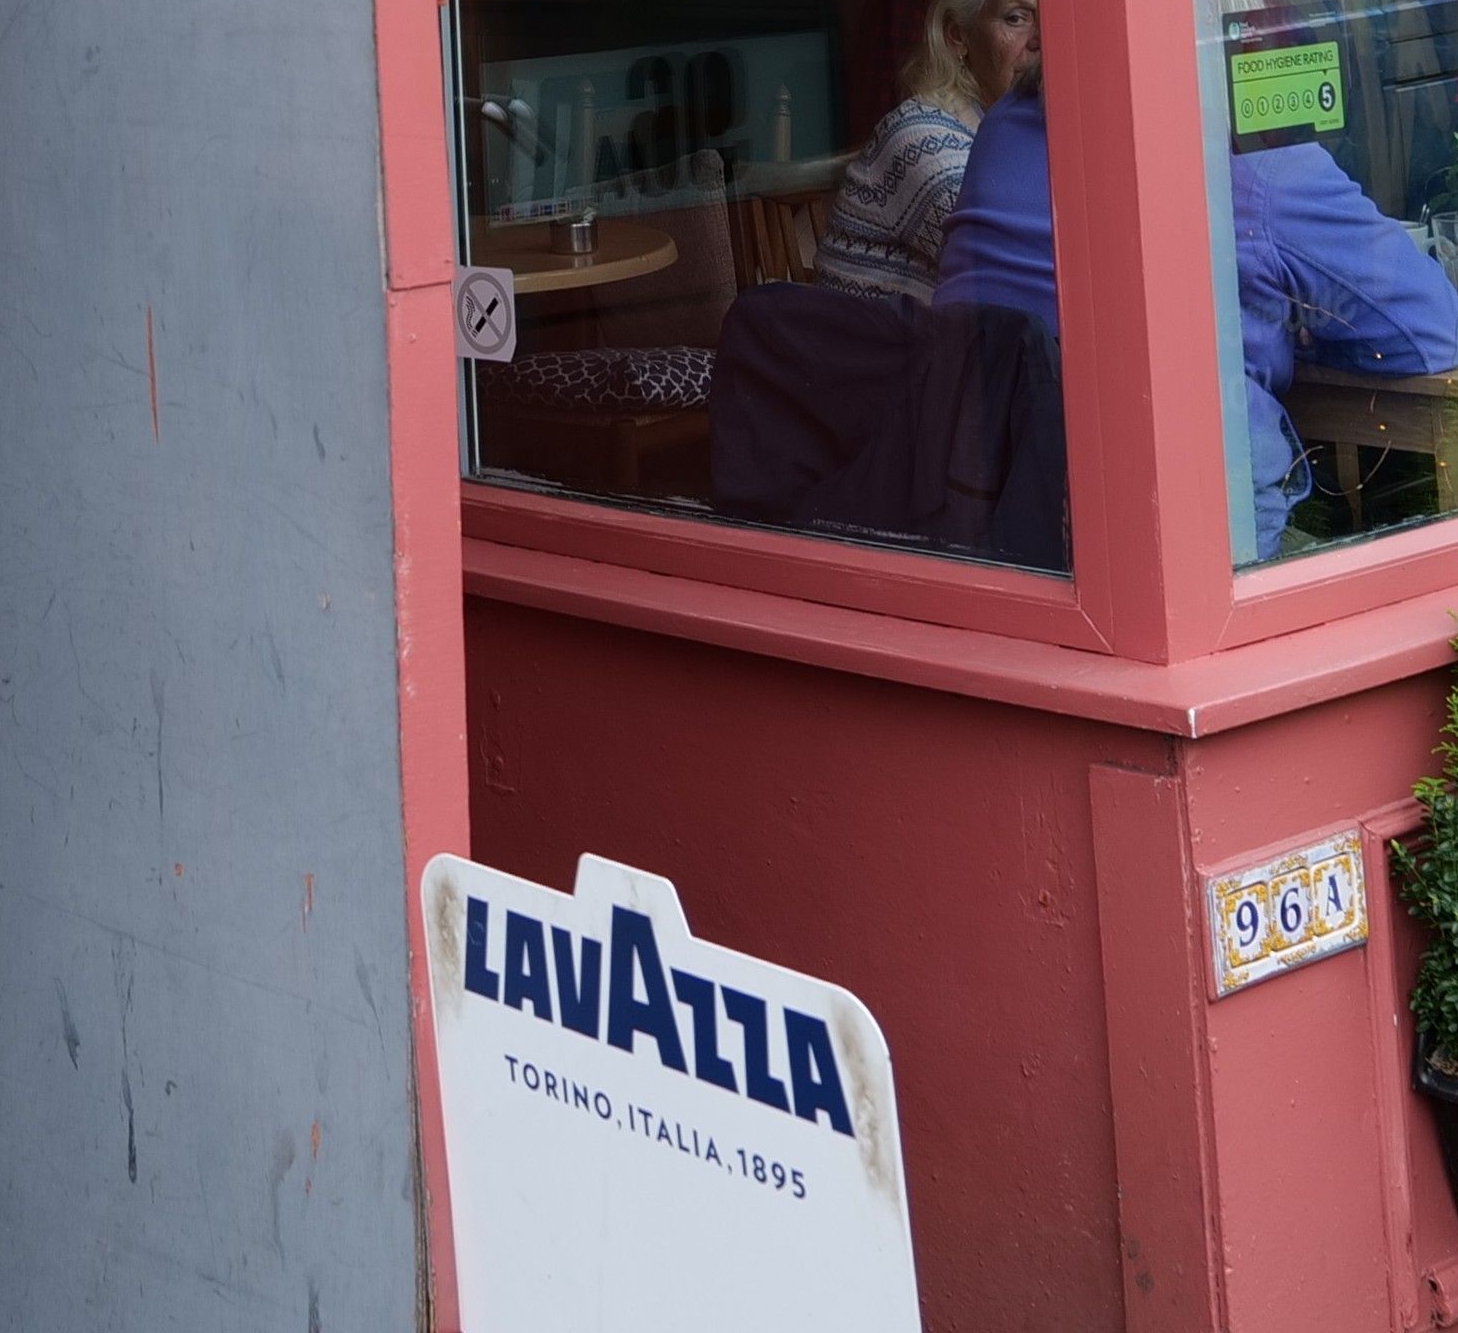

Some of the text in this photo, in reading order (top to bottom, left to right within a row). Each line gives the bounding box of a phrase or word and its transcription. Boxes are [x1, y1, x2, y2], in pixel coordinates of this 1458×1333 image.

[1238, 49, 1334, 75] FOOD HYGIENE RATING
[1235, 873, 1343, 948] 96A
[464, 894, 856, 1139] LAVAZZA
